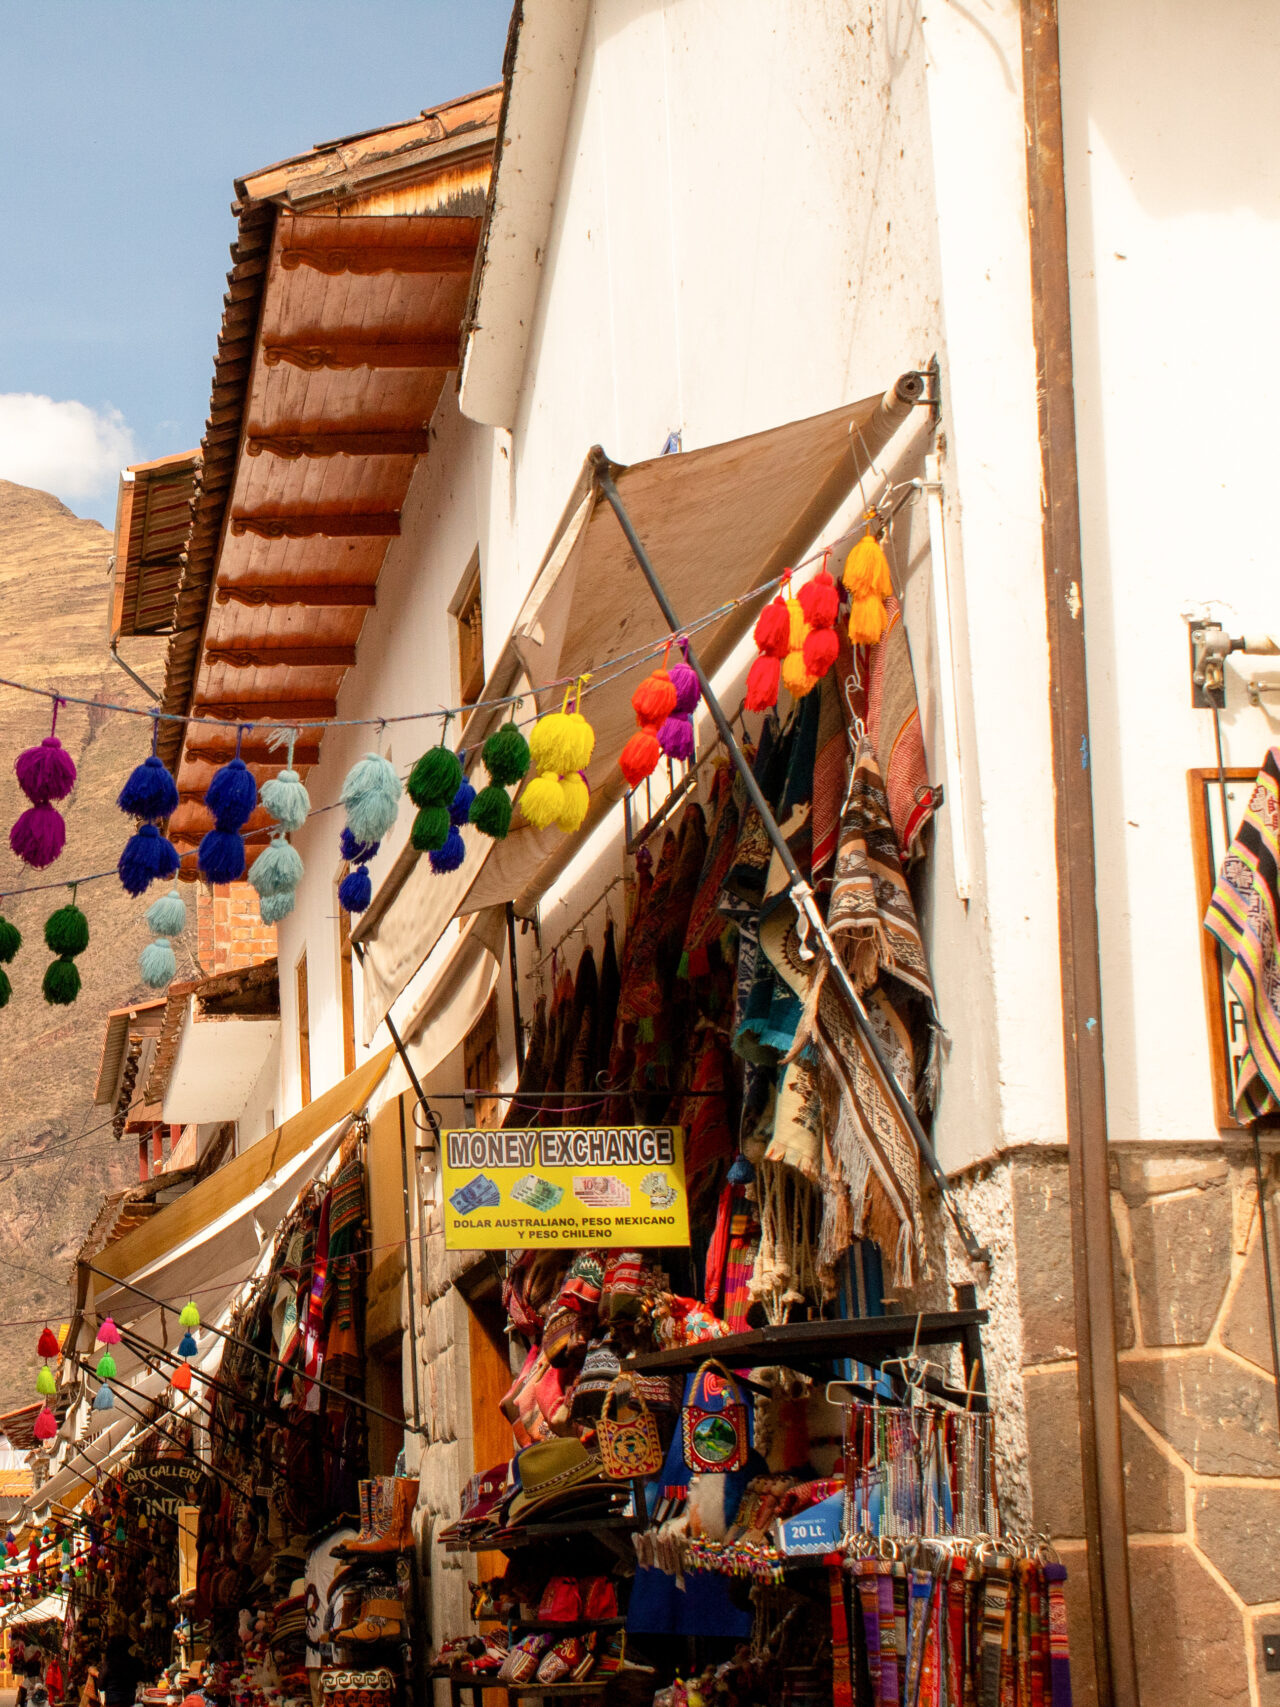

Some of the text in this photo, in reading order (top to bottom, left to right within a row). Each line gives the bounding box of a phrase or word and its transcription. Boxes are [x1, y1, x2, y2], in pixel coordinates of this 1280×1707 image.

[447, 1128, 675, 1169] MONEY EXCHANGE
[453, 1216, 675, 1228] DOLAR AUSTRALIANO, PESO MEXICANO
[518, 1229, 612, 1239] Y PESO CHILENO
[127, 1465, 202, 1485] ART GALLERY
[791, 1524, 825, 1539] 20 Lt.
